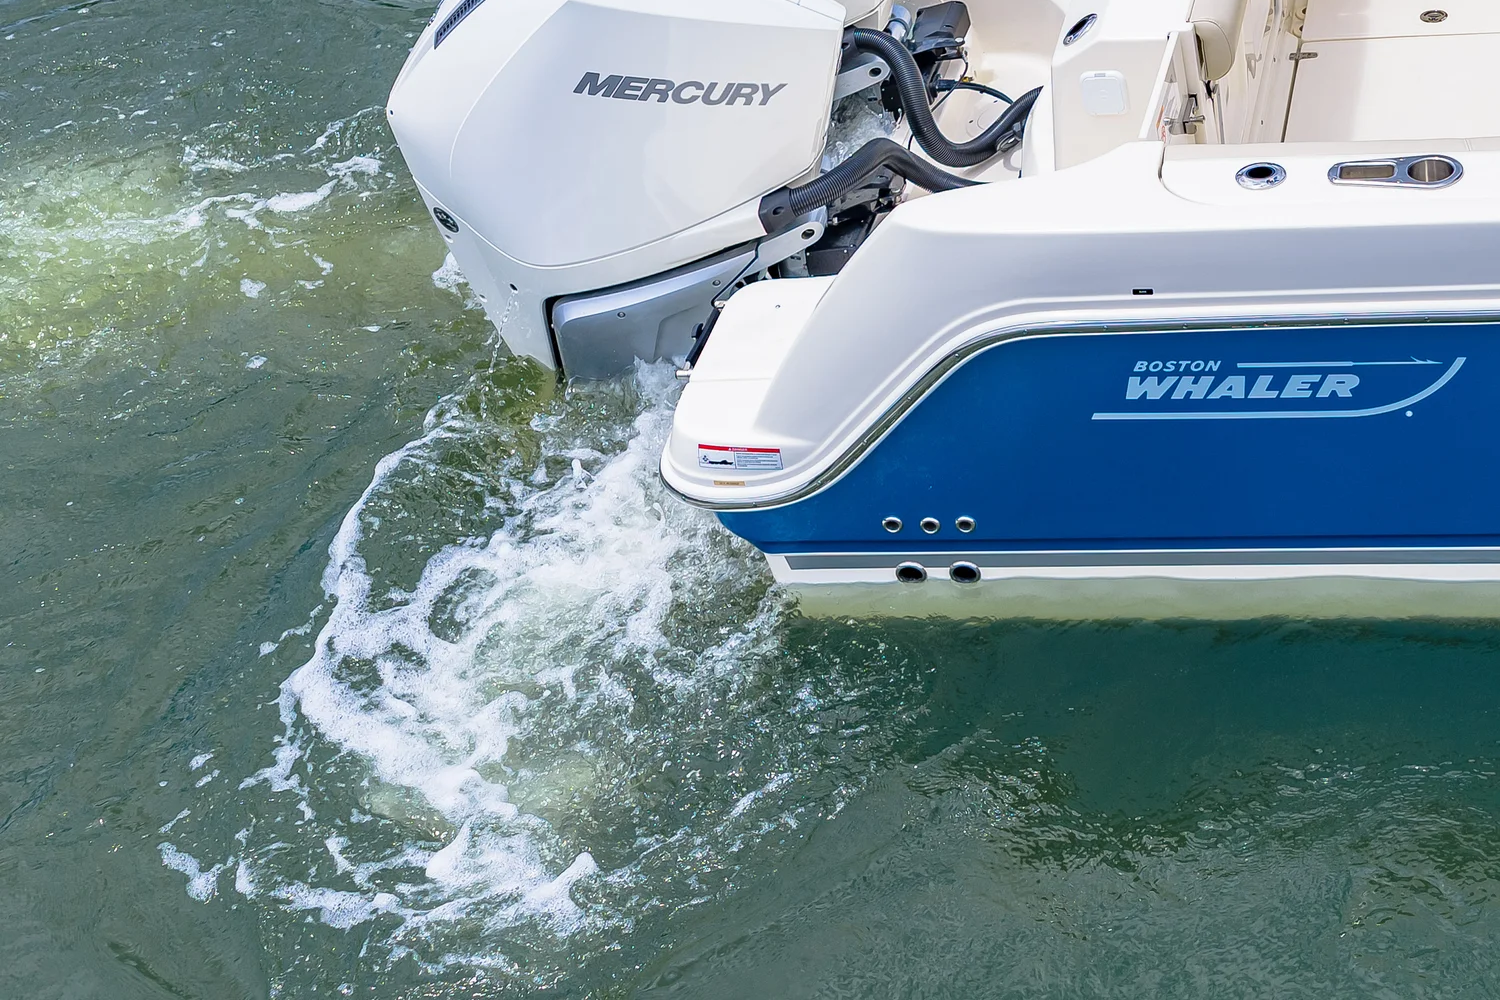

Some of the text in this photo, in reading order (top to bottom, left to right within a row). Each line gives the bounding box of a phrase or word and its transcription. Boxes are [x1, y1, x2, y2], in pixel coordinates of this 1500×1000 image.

[573, 71, 788, 107] MERCURY
[1133, 360, 1221, 372] BOSTON
[1126, 374, 1360, 399] WHALER
